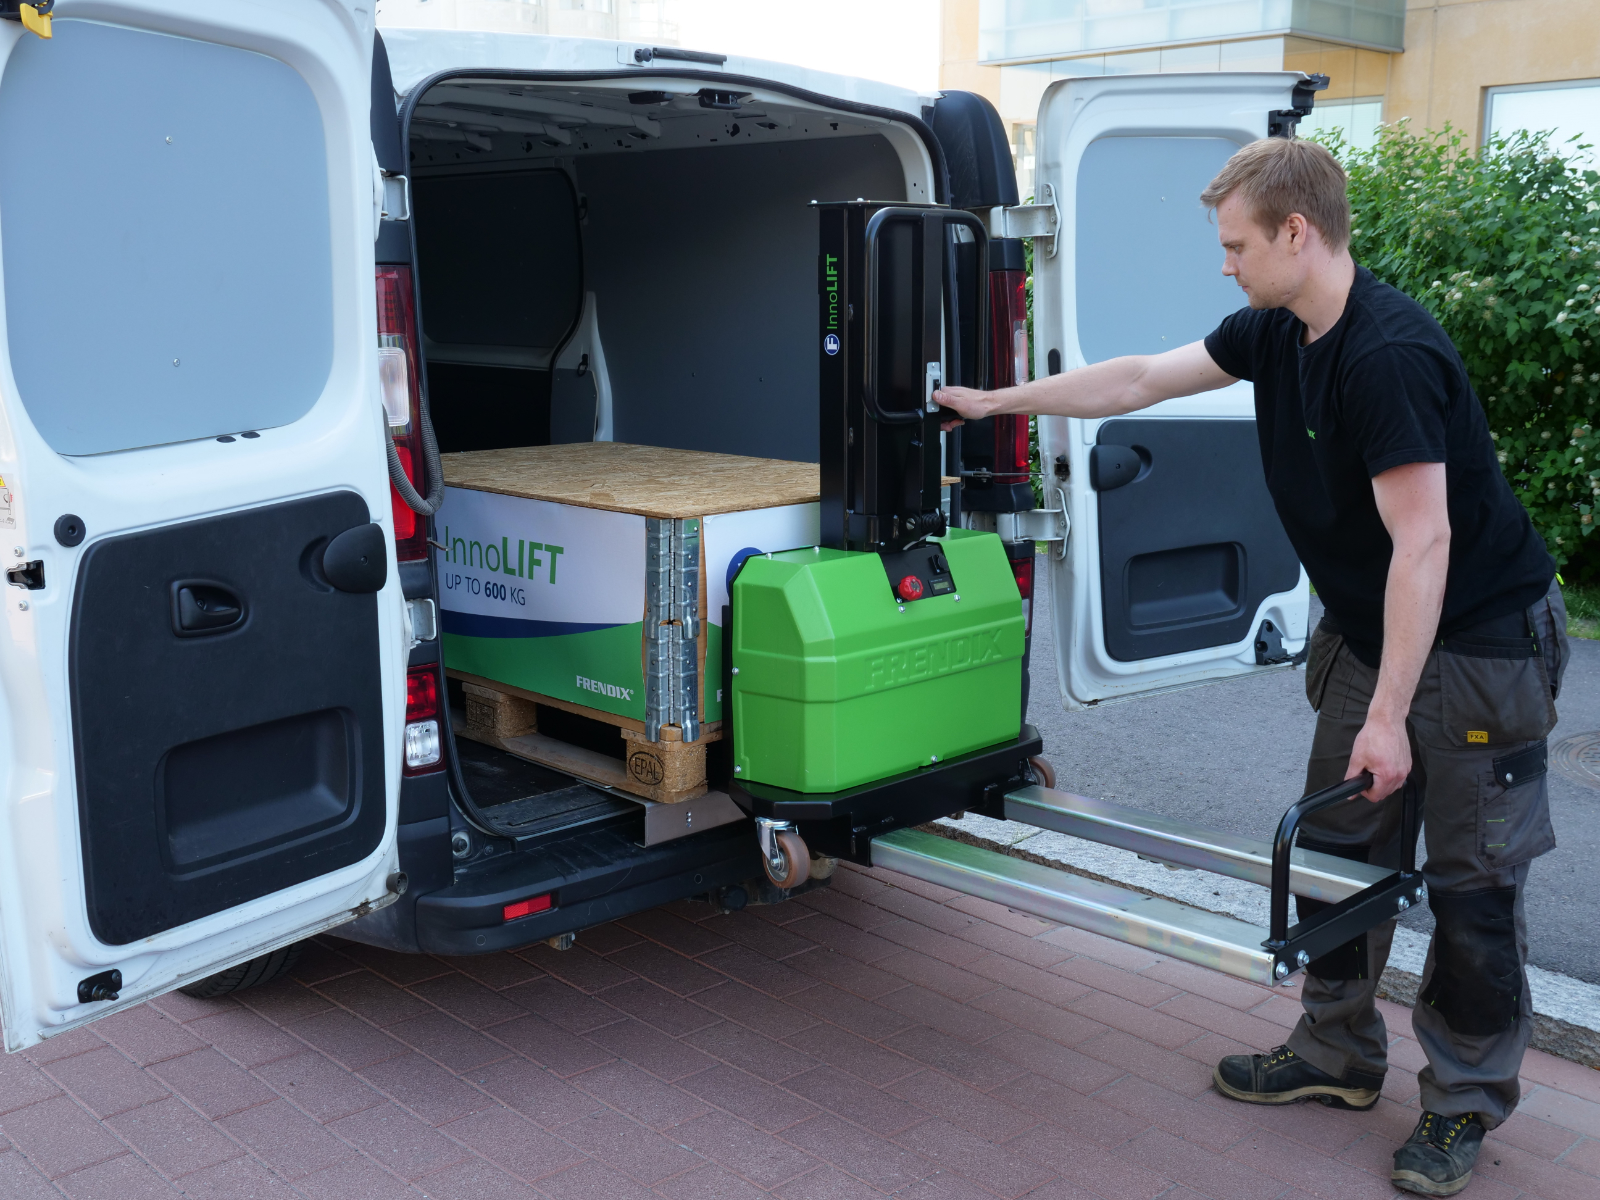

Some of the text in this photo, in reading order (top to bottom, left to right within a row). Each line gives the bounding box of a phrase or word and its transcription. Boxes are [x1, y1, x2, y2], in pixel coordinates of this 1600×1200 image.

[826, 253, 838, 330] InnoLIFT
[445, 525, 564, 585] InnoLIFT
[445, 572, 526, 606] UP TO 600 KG
[864, 627, 1002, 690] FRENDIX
[635, 757, 660, 781] EPAL
